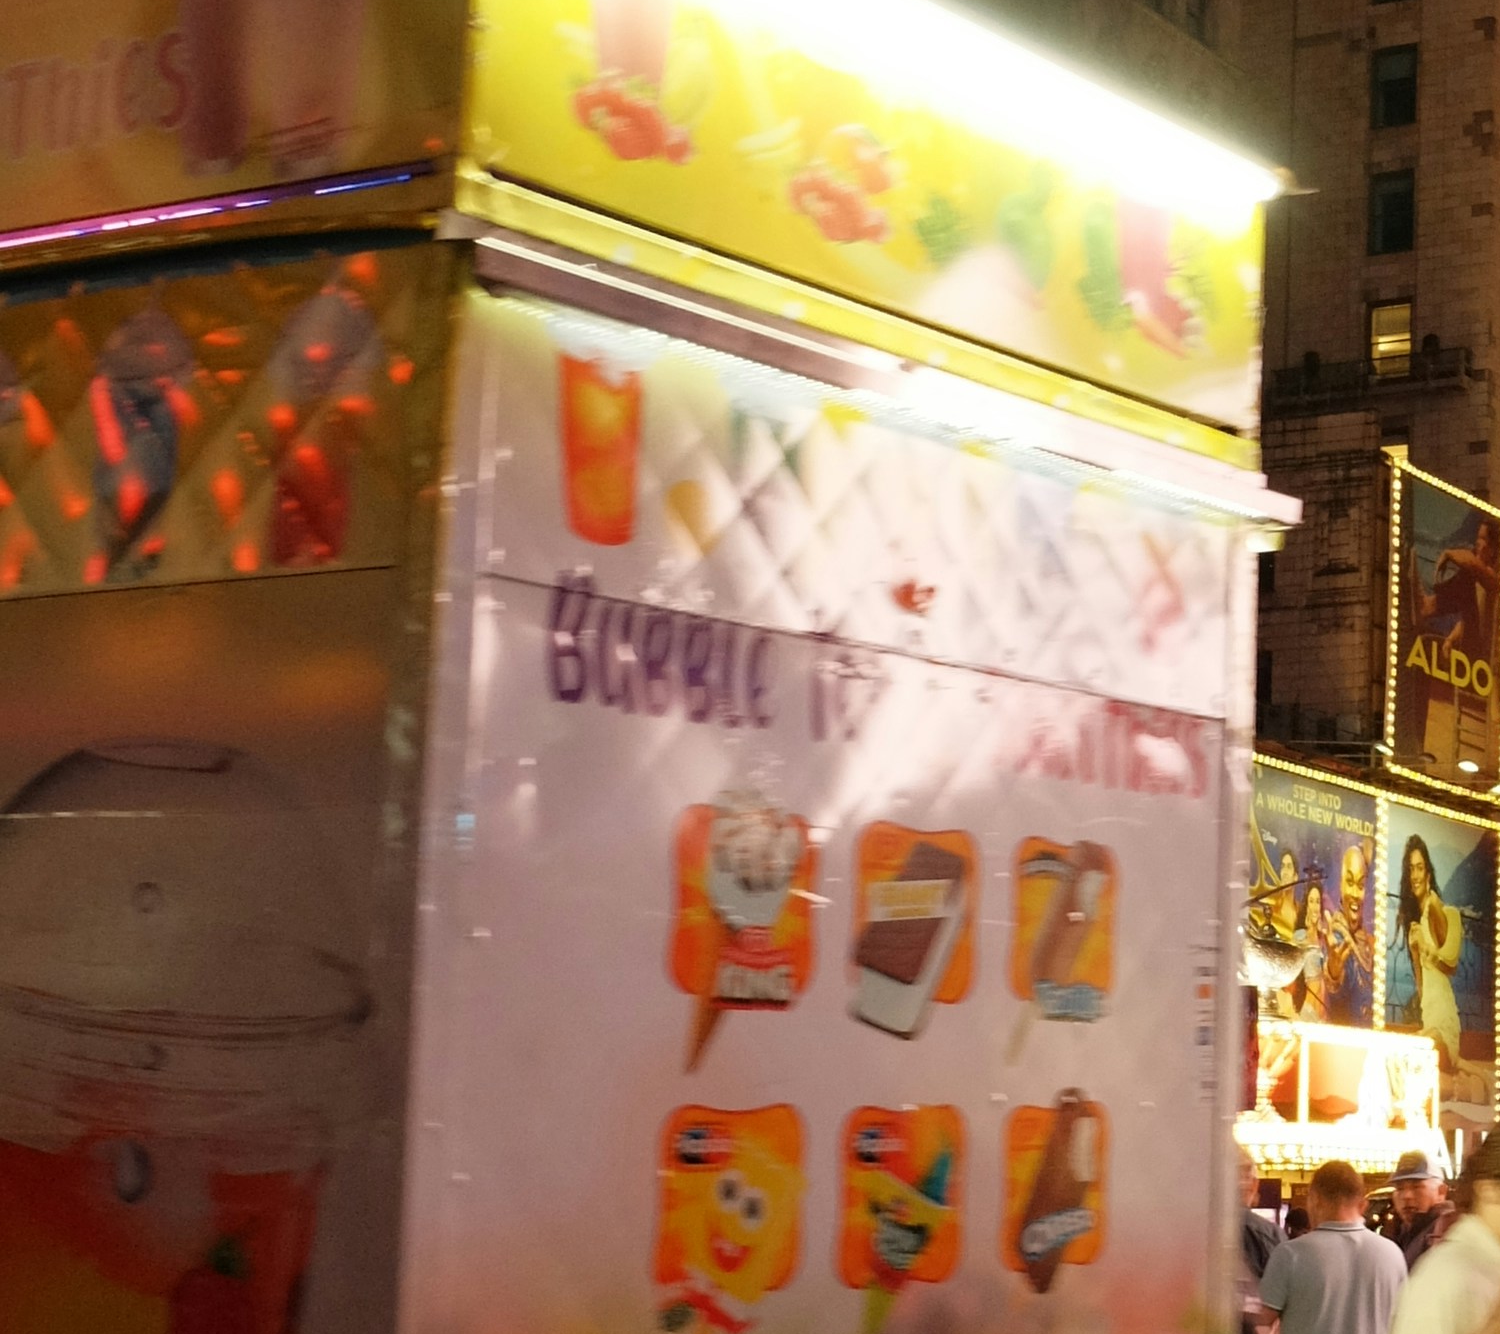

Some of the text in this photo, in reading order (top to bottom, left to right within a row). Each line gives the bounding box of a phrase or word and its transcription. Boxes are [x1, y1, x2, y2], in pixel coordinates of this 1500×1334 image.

[1406, 636, 1494, 698] ALDO
[1255, 792, 1264, 808] A
[1267, 794, 1306, 820] WHOLE
[1308, 805, 1333, 827] NEW
[1293, 784, 1341, 810] STEP INTO
